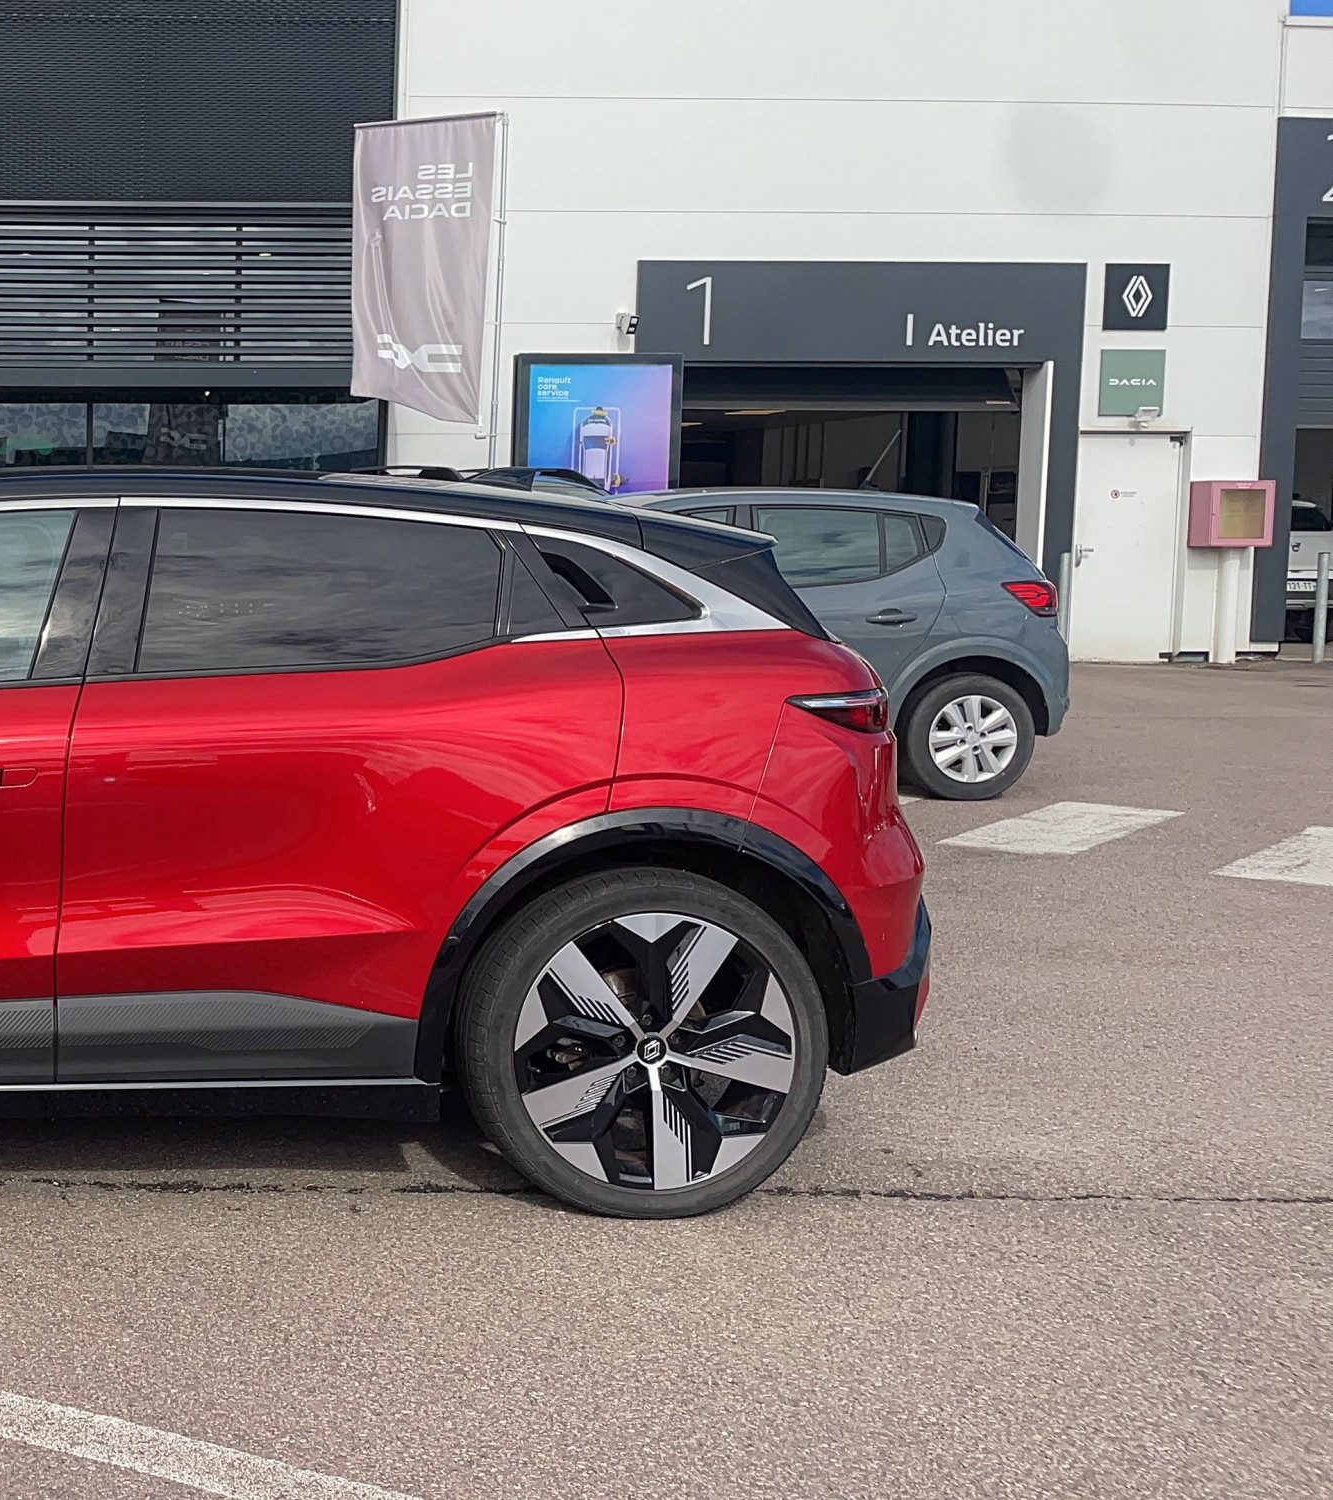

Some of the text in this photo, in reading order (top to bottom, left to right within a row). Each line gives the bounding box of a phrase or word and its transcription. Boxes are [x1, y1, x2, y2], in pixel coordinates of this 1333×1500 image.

[686, 276, 713, 345] 1
[928, 322, 1024, 347] Atelier
[538, 376, 572, 384] Renault
[1108, 378, 1157, 386] DACIA
